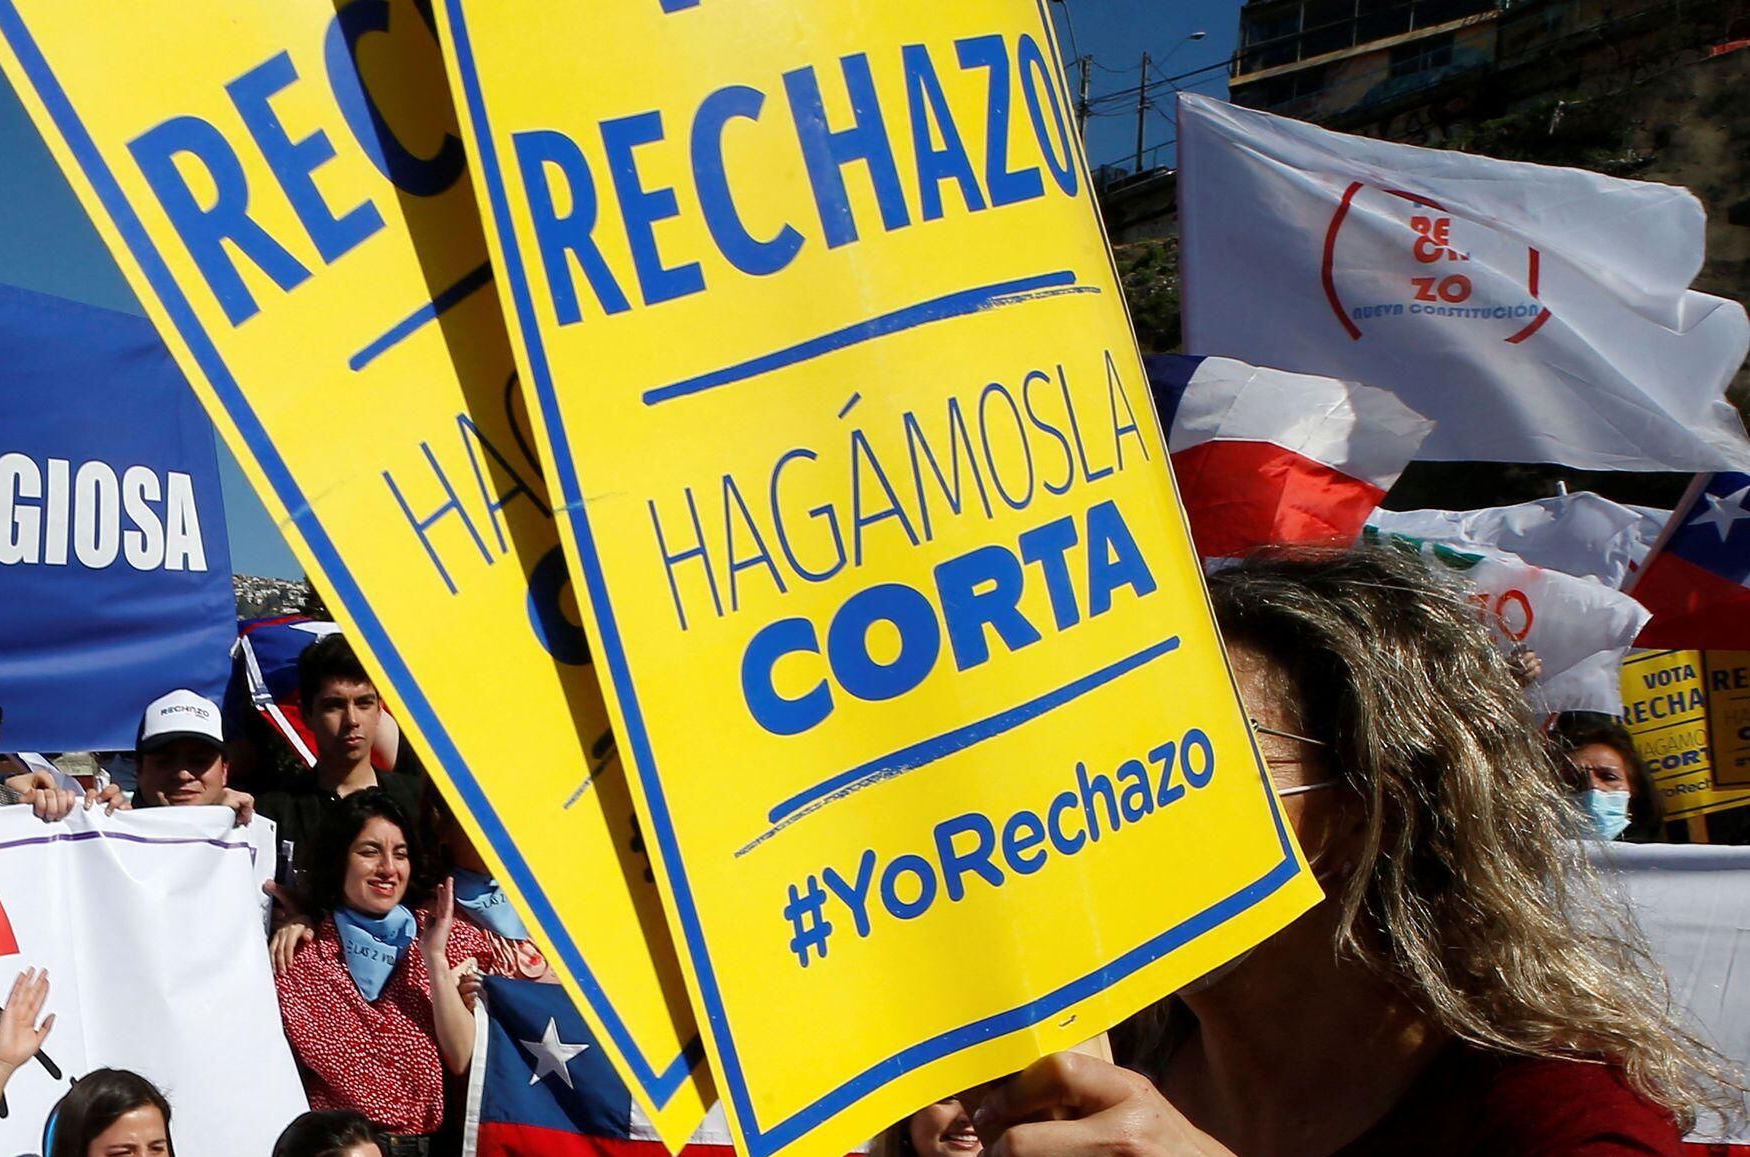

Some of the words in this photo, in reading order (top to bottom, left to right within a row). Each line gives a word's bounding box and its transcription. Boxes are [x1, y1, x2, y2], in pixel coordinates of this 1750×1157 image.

[511, 33, 1078, 327] RECHAZO
[1411, 274, 1472, 303] ZO
[648, 349, 1151, 631] HAGÁMOSLA
[740, 499, 1158, 737] CORTA
[1642, 664, 1696, 690] VOTA
[1615, 687, 1707, 727] RECHA
[1645, 747, 1712, 774] CORT
[783, 727, 1215, 967] #YoRechazo
